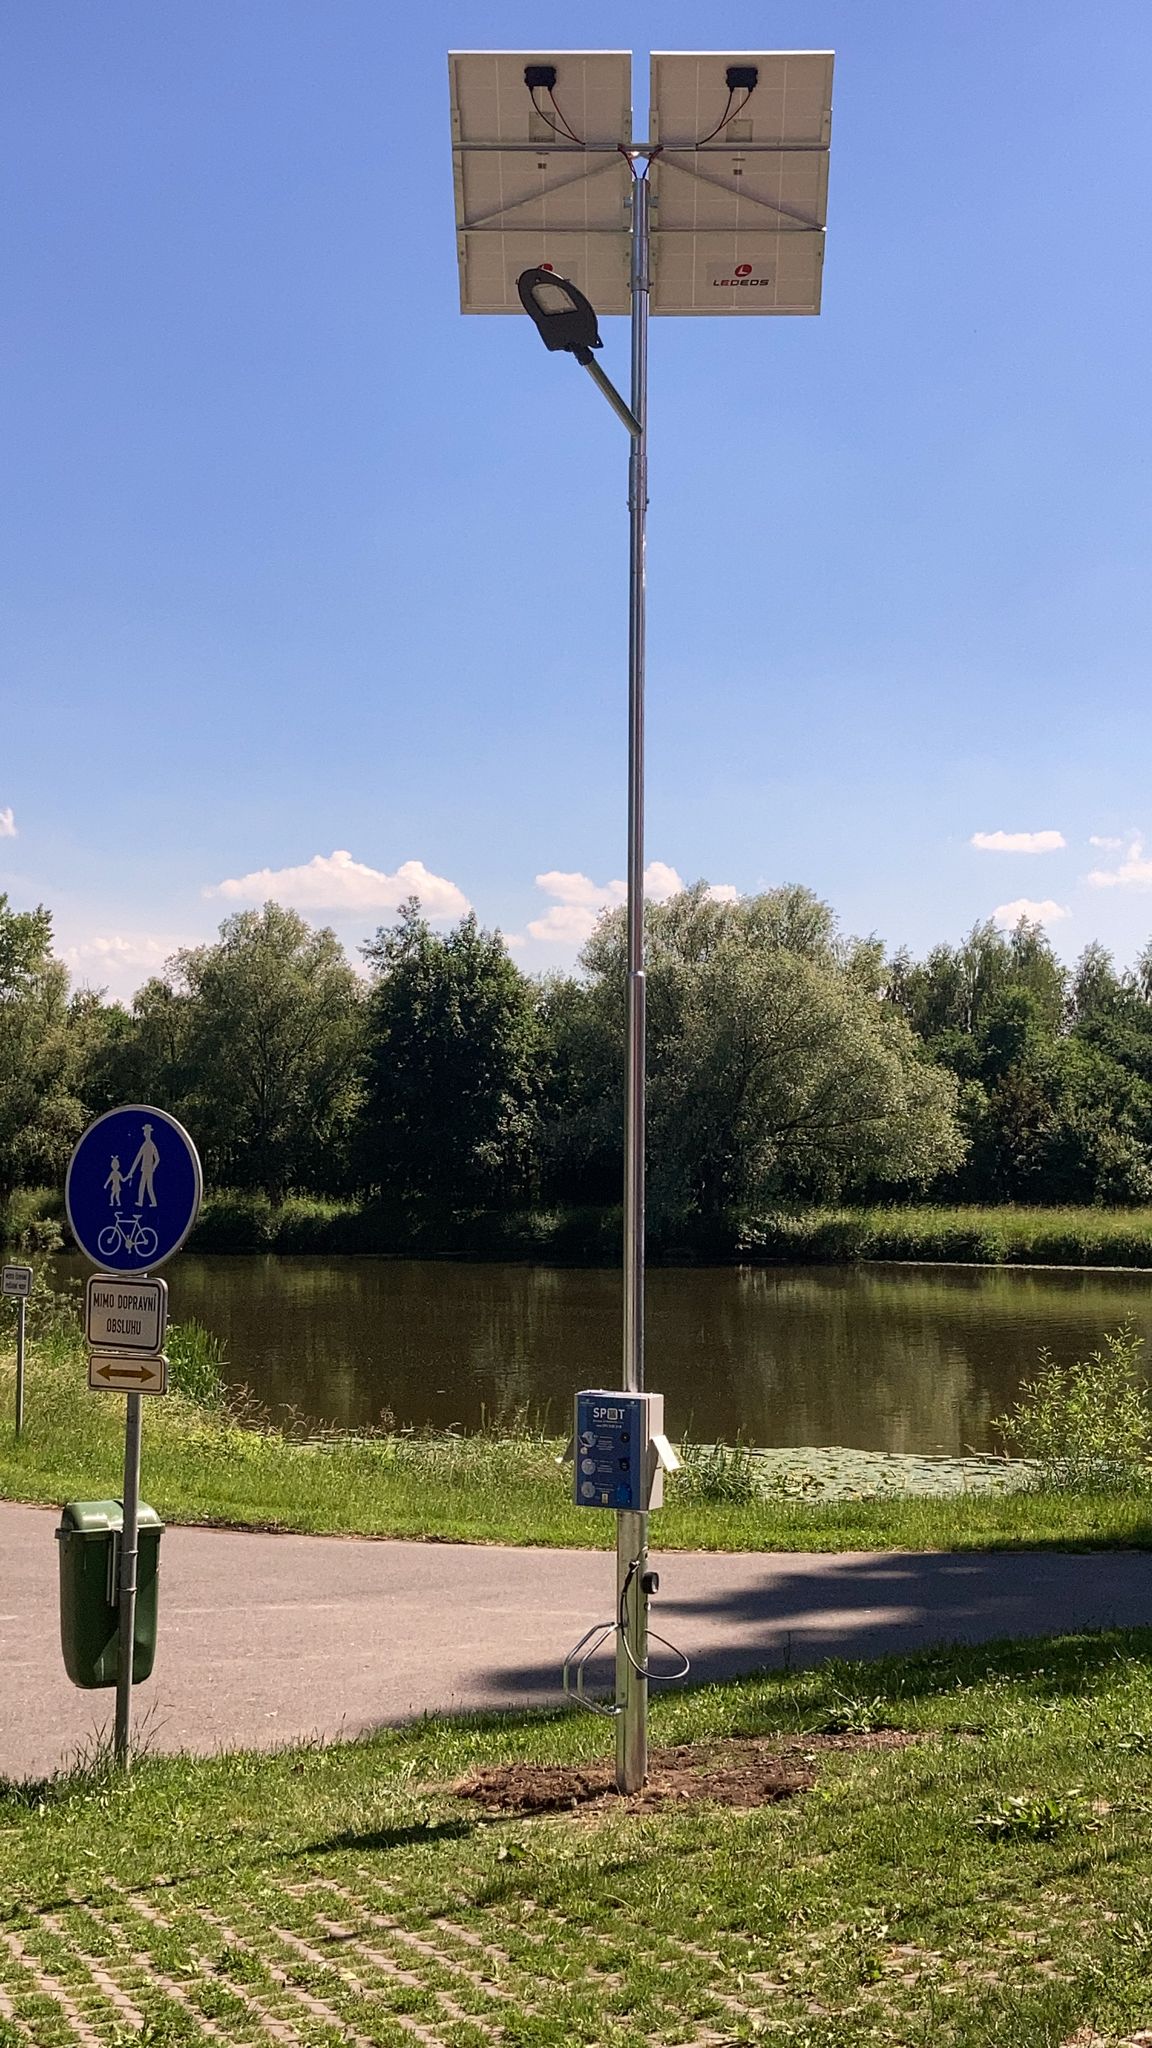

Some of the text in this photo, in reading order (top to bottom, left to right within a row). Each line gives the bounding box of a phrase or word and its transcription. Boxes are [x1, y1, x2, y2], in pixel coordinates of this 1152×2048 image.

[93, 1292, 157, 1312] MIMO DOPRAVNÍ
[106, 1318, 142, 1335] OBSLUHU
